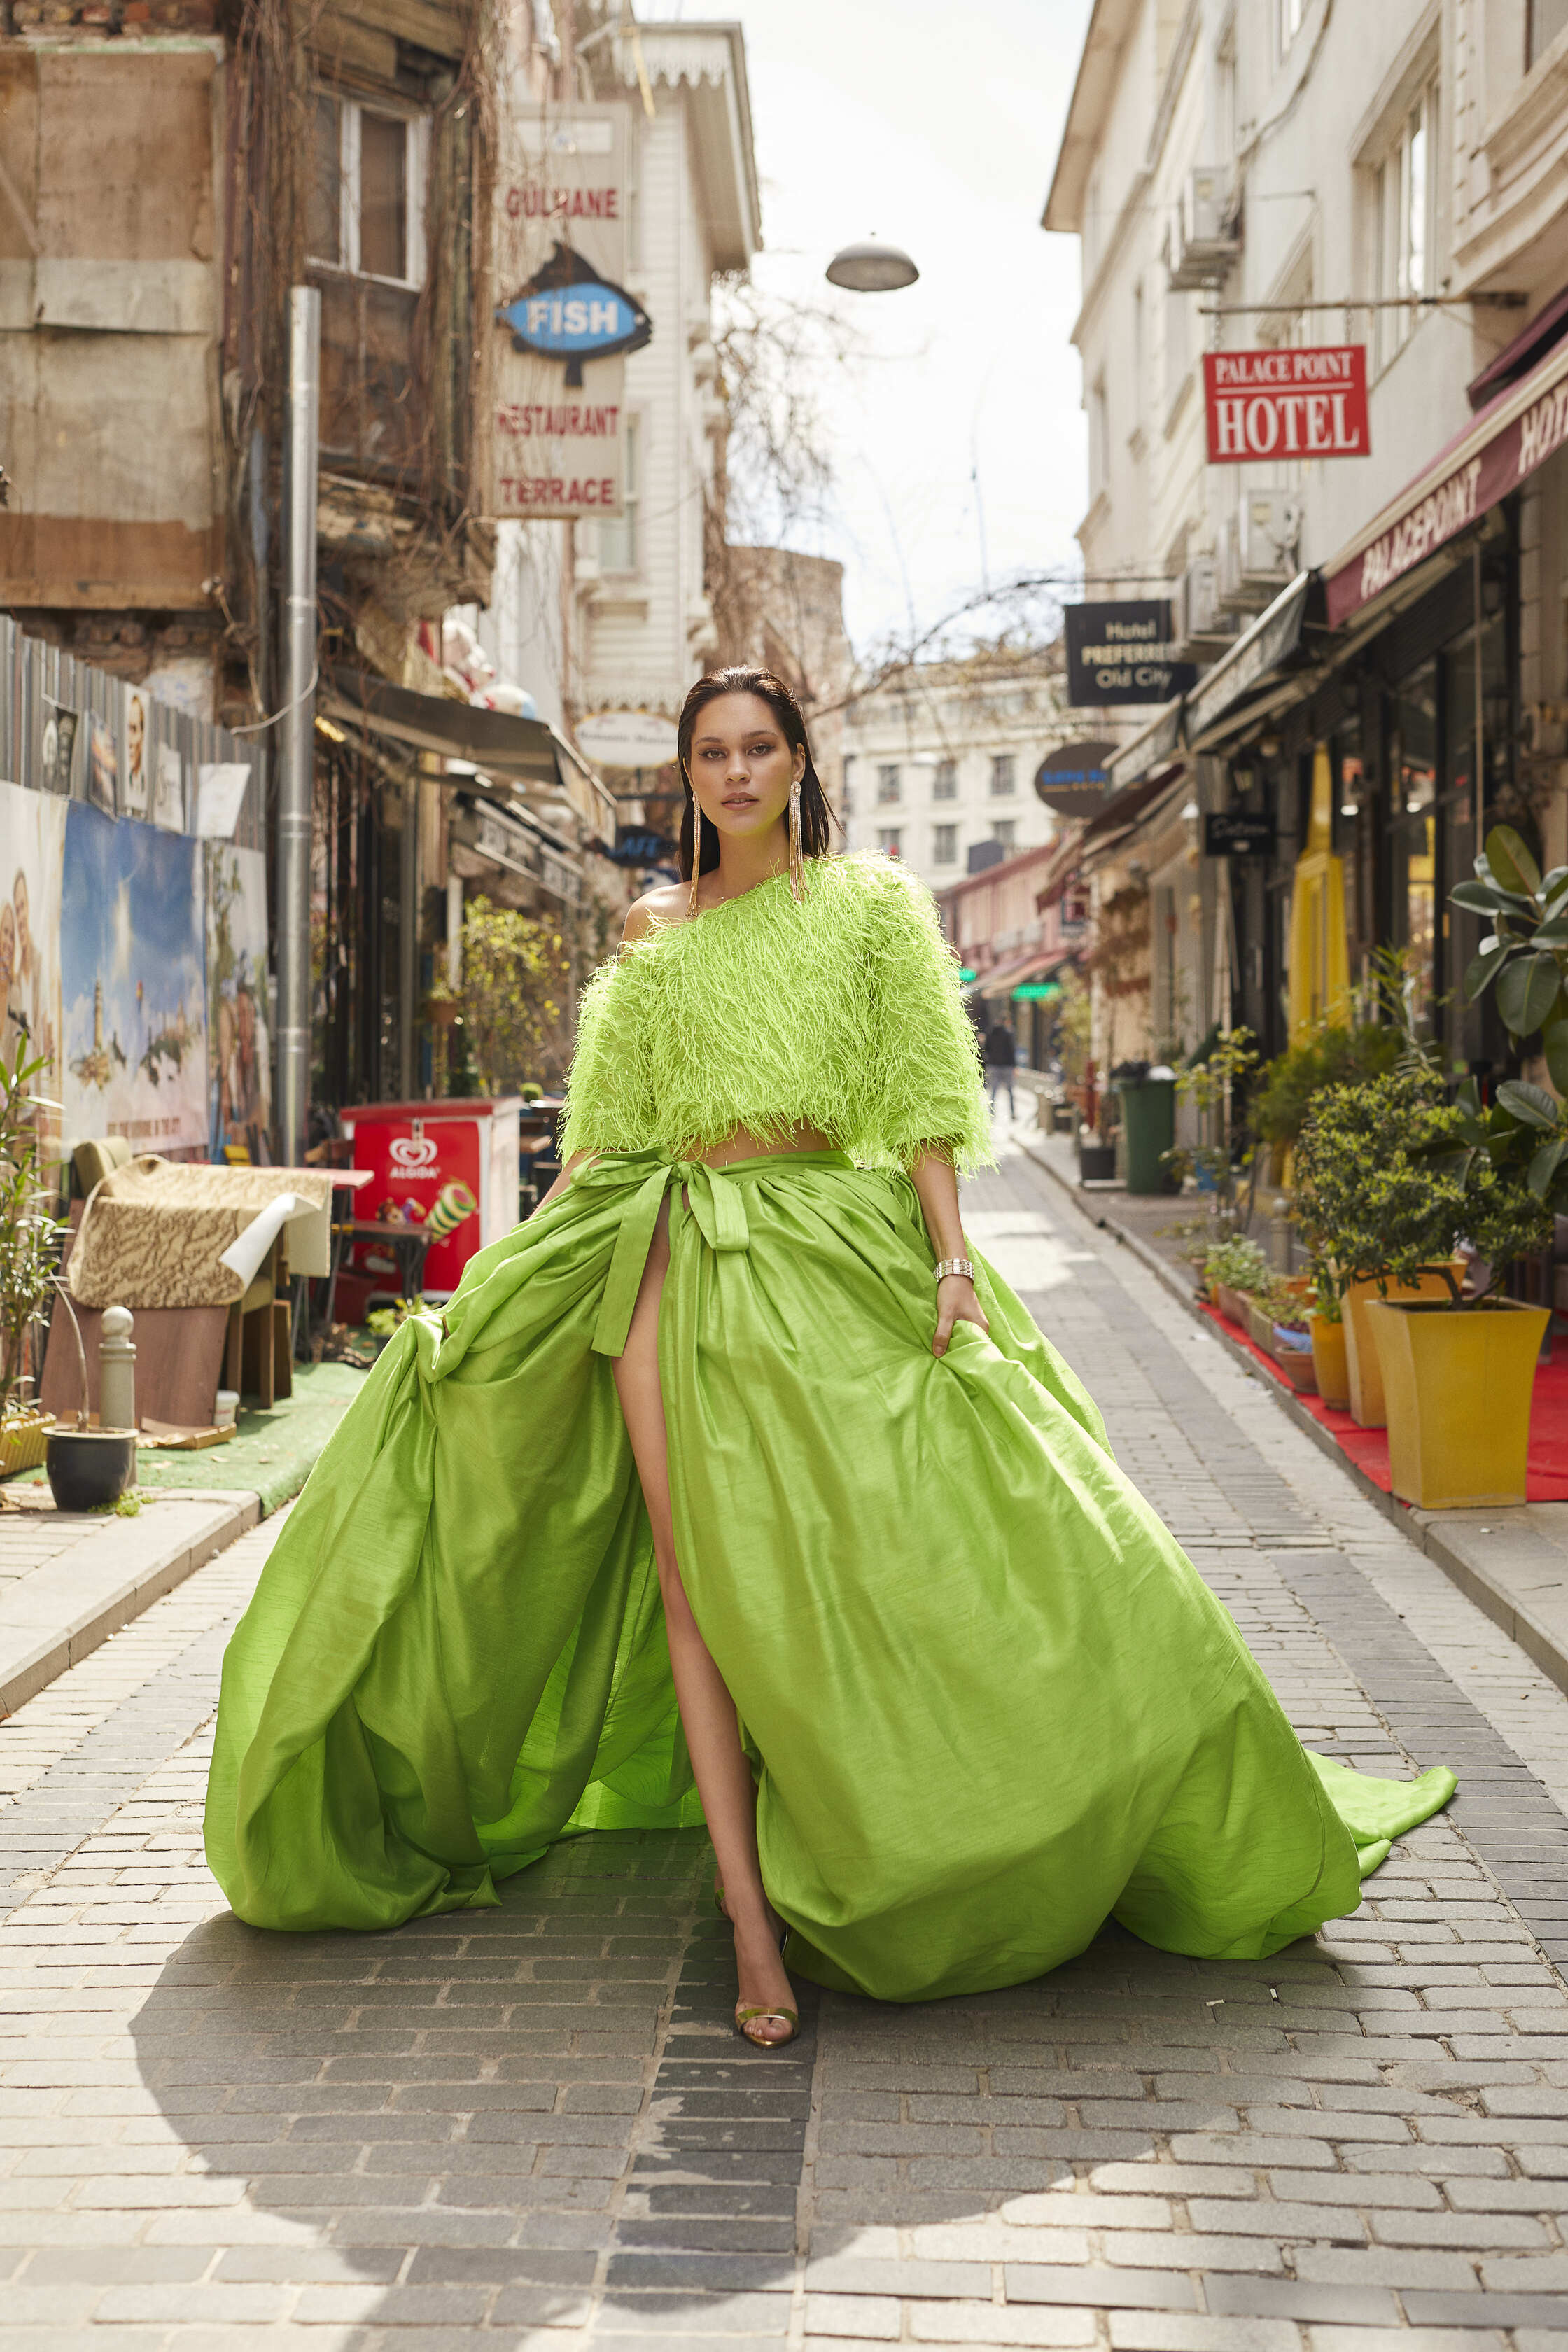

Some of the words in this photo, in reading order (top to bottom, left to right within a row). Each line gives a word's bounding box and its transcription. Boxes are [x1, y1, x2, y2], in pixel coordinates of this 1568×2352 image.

[527, 300, 619, 335] FISH
[1214, 354, 1292, 384] PALACE
[1294, 350, 1354, 382] POINT
[1214, 393, 1361, 455] HOTEL
[500, 477, 615, 505] TERRACE
[1105, 618, 1157, 641] Hotel
[1096, 667, 1133, 689] Old
[1135, 666, 1173, 690] City
